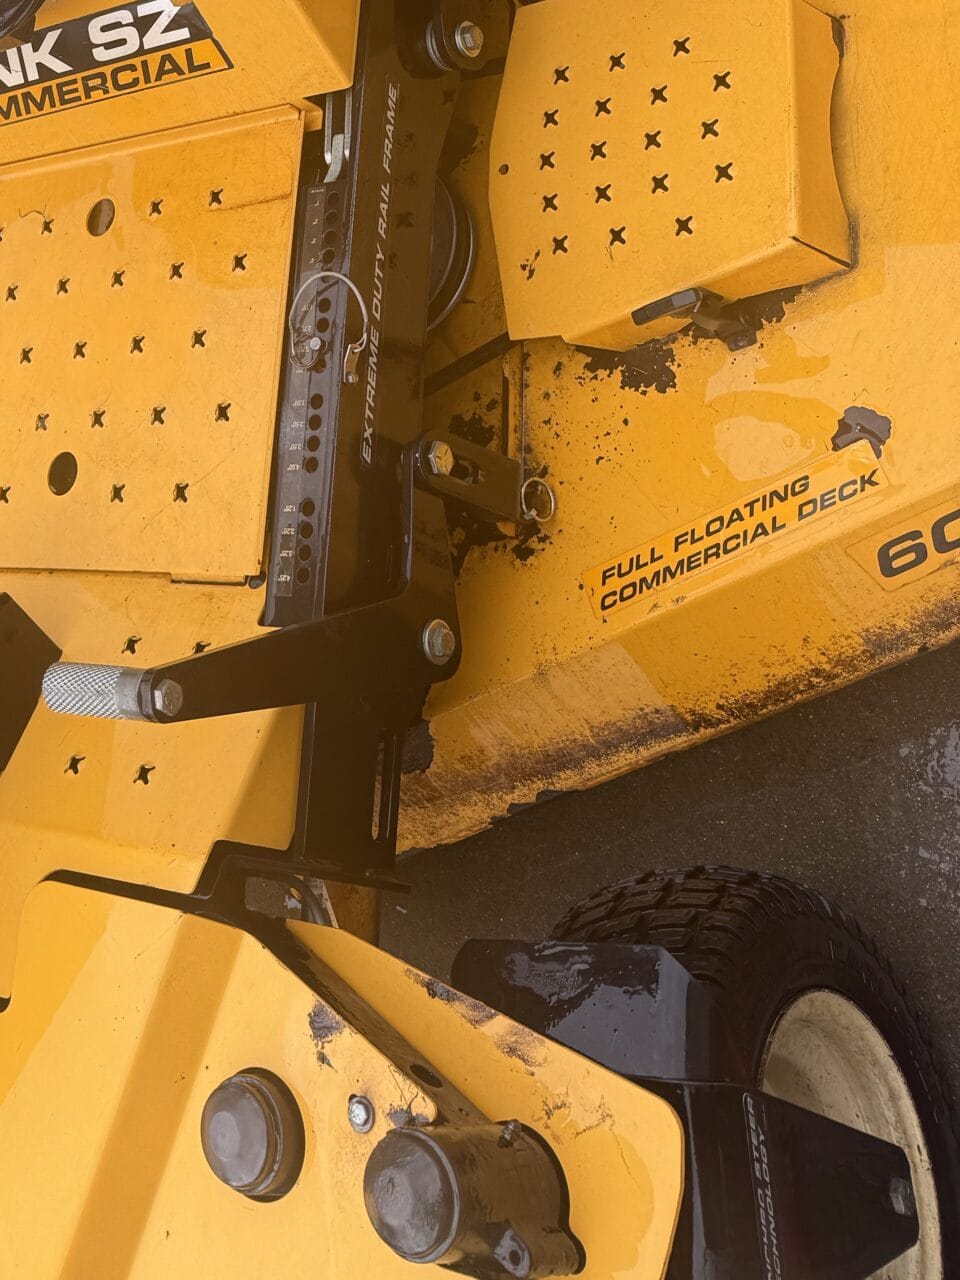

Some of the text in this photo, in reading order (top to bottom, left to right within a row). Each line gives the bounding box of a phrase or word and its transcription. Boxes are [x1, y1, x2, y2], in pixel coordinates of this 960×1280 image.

[362, 85, 398, 465] EXTREME DUTY RAIL FRAME
[600, 468, 880, 612] COMMERCIAL DECK
[601, 474, 811, 587] FULL FLOATING
[746, 1097, 762, 1181] STEER
[757, 1126, 782, 1280] ECHNOLOGY
